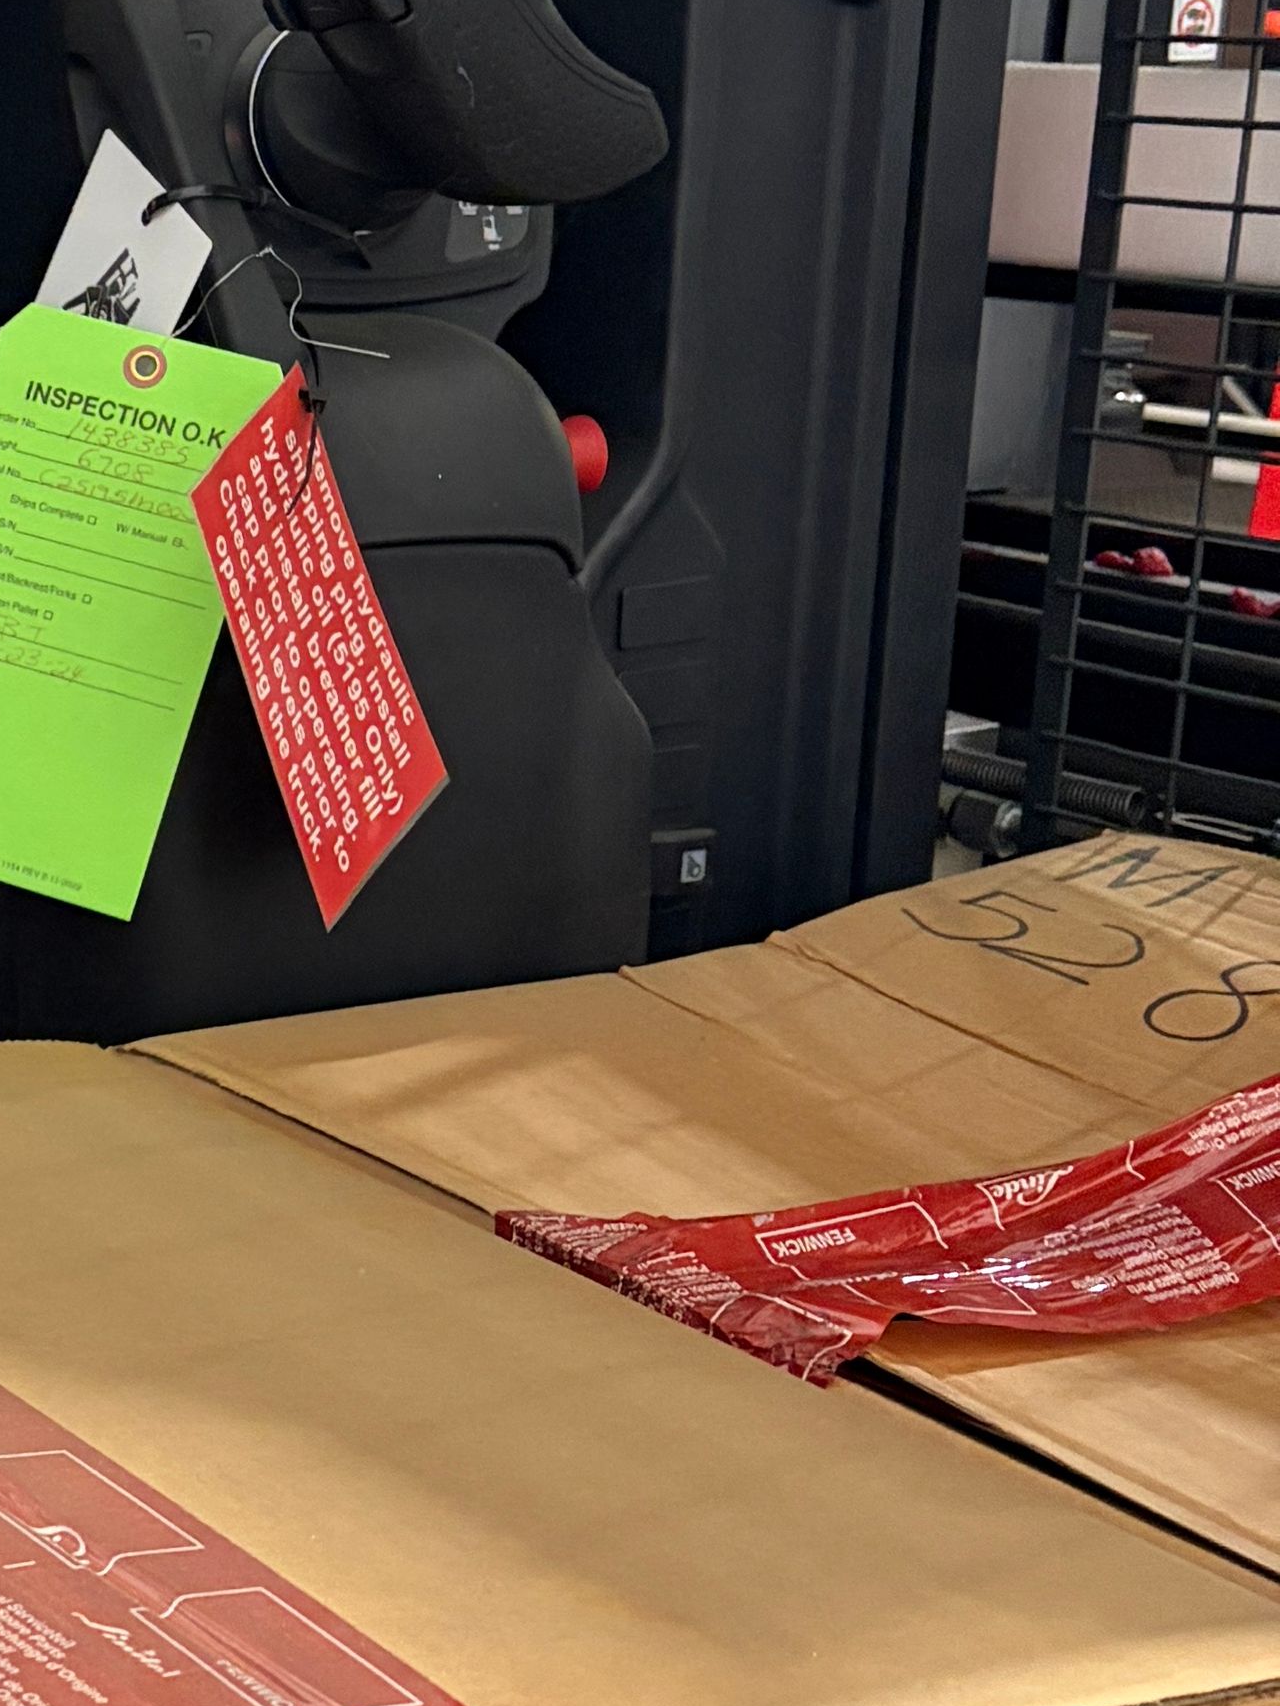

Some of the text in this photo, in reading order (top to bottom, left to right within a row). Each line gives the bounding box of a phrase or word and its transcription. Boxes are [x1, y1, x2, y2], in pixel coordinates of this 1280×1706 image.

[23, 378, 177, 438] INSPECTION
[8, 492, 85, 523] Ships Complete
[130, 526, 168, 544] Manual
[11, 600, 39, 616] Pallet
[219, 478, 350, 872] Check oil levels prior to
[234, 473, 359, 839] cap prior to operating.
[249, 455, 384, 821] and install breather fill
[330, 581, 366, 666] plug,
[366, 667, 411, 769] install
[353, 574, 414, 725] hydraulic
[215, 534, 322, 862] operating the truck.
[311, 585, 334, 627] oil
[327, 632, 370, 721] (5195
[365, 725, 404, 815] Only)
[771, 1225, 857, 1259] FENWICK
[993, 1165, 1074, 1207] Linde
